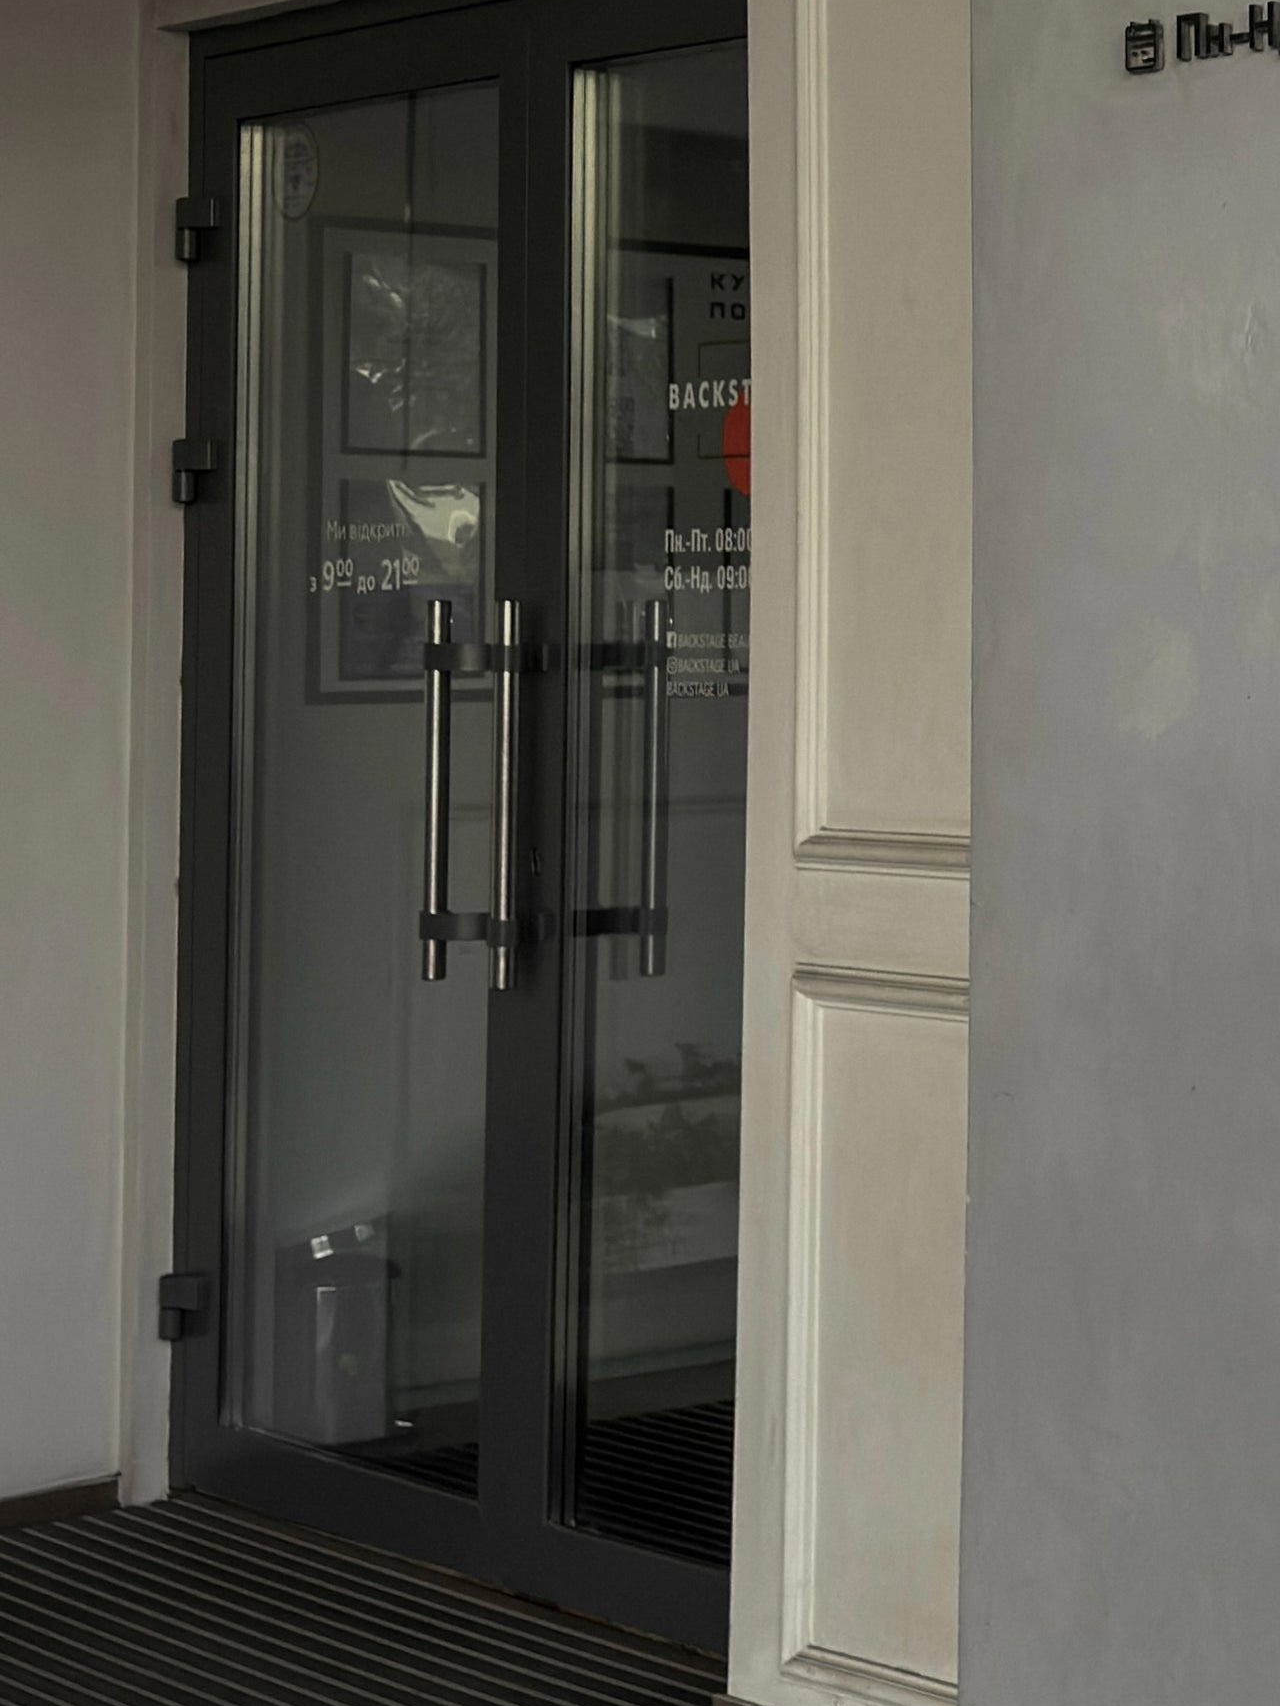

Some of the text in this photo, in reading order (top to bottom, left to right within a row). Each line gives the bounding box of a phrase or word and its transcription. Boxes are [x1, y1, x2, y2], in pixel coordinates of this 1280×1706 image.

[326, 520, 347, 540] Ми
[665, 528, 711, 553] Пн.-Пт.
[356, 575, 376, 595] до
[717, 565, 751, 589] 09:0
